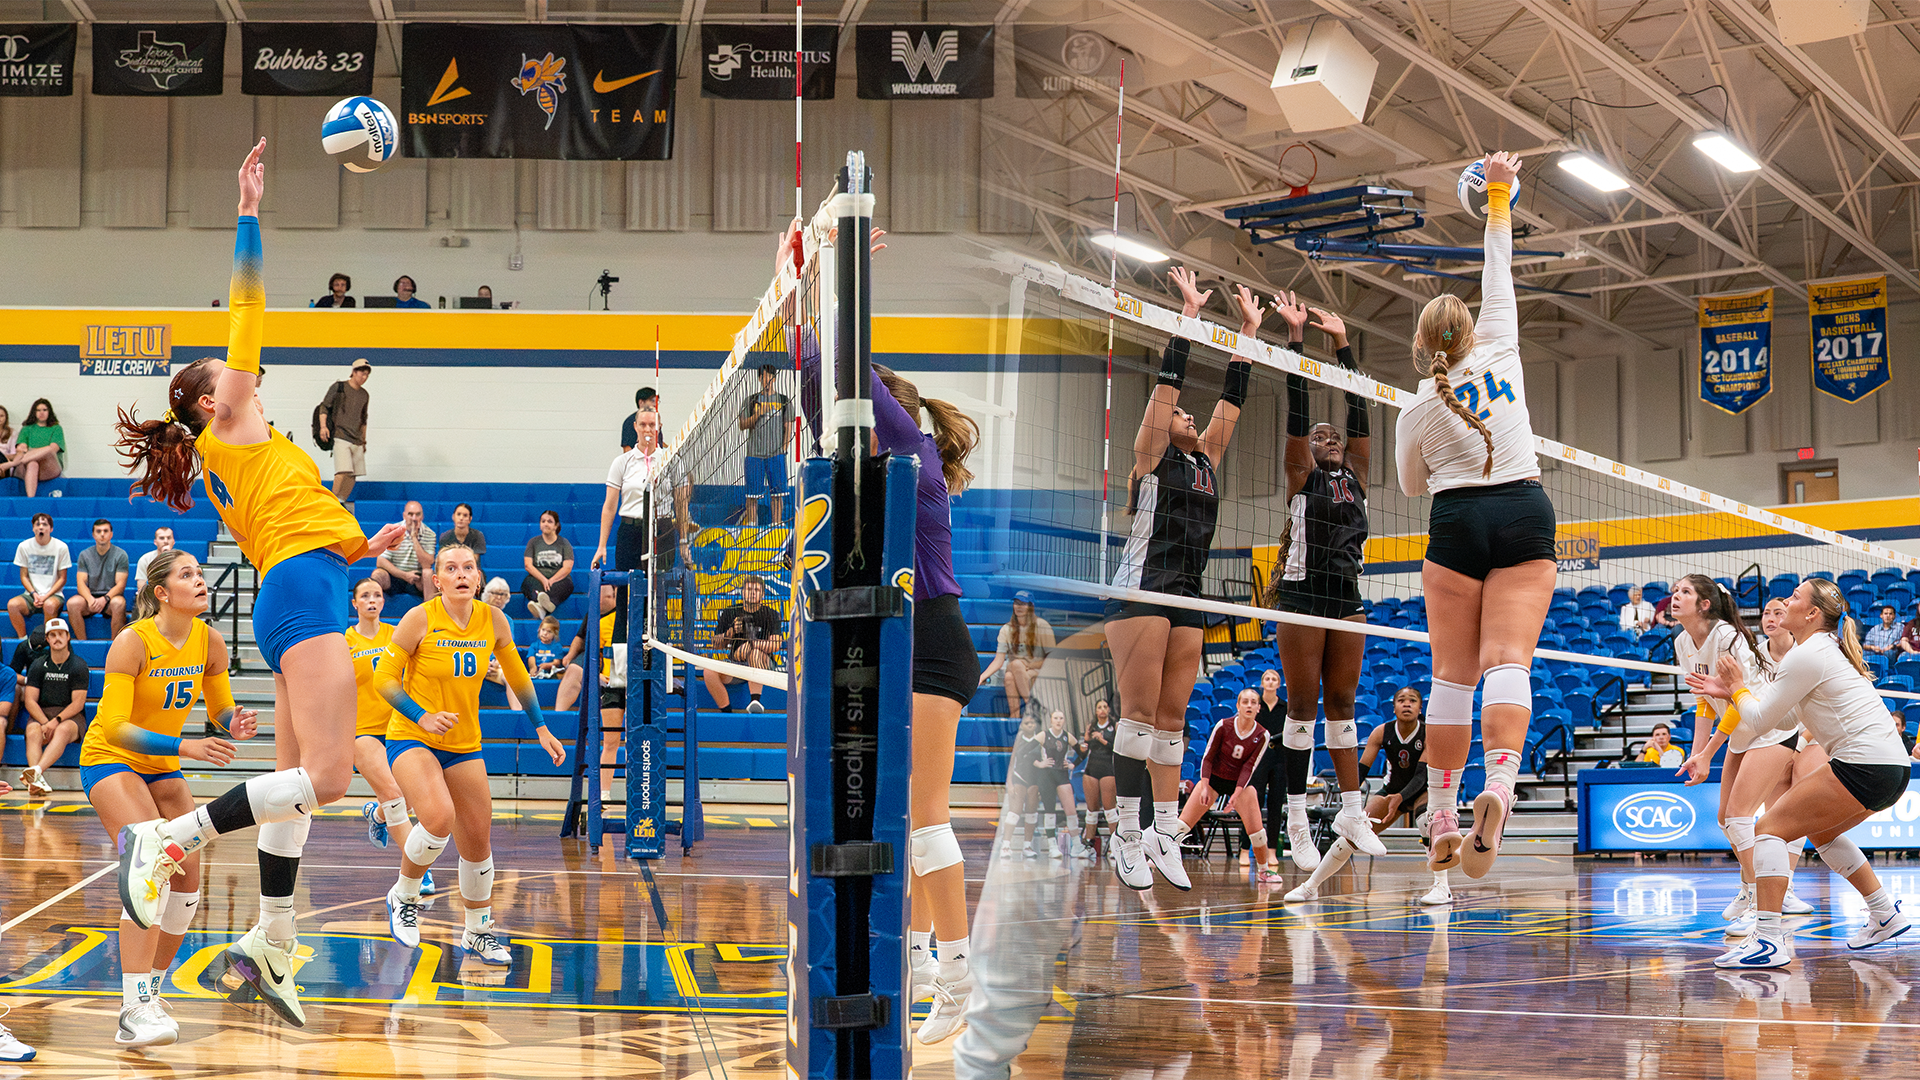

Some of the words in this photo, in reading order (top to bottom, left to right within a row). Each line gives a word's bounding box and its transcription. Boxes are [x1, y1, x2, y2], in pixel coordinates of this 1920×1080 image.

[254, 47, 328, 71] Bubba's
[330, 51, 364, 73] 33
[750, 49, 831, 63] CHRITUS
[892, 83, 957, 94] WHATABURGER
[590, 109, 667, 124] TEAM
[363, 111, 382, 153] molten
[1115, 295, 1143, 318] LETU
[86, 325, 165, 356] LETU
[1211, 327, 1237, 349] LETU
[1716, 331, 1758, 344] BASEBALL
[1820, 322, 1876, 336] BASKETBALL
[1817, 332, 1883, 361] 2017
[94, 359, 122, 375] BLUE
[122, 359, 155, 375] CREW
[1299, 357, 1321, 378] LETU
[1705, 346, 1768, 373] 2014
[1375, 383, 1396, 402] LETU
[1714, 381, 1760, 393] CHAMPIONS
[1453, 368, 1517, 430] 24
[1191, 464, 1214, 495] 11
[1556, 559, 1585, 571] FANS
[436, 639, 487, 648] LETOURNEAU
[452, 651, 477, 678] 18
[162, 680, 194, 710] 15
[641, 740, 651, 771] sports
[1231, 744, 1245, 760] 8
[843, 733, 865, 819] ports
[641, 772, 651, 810] imports
[1625, 805, 1683, 828] SCAC
